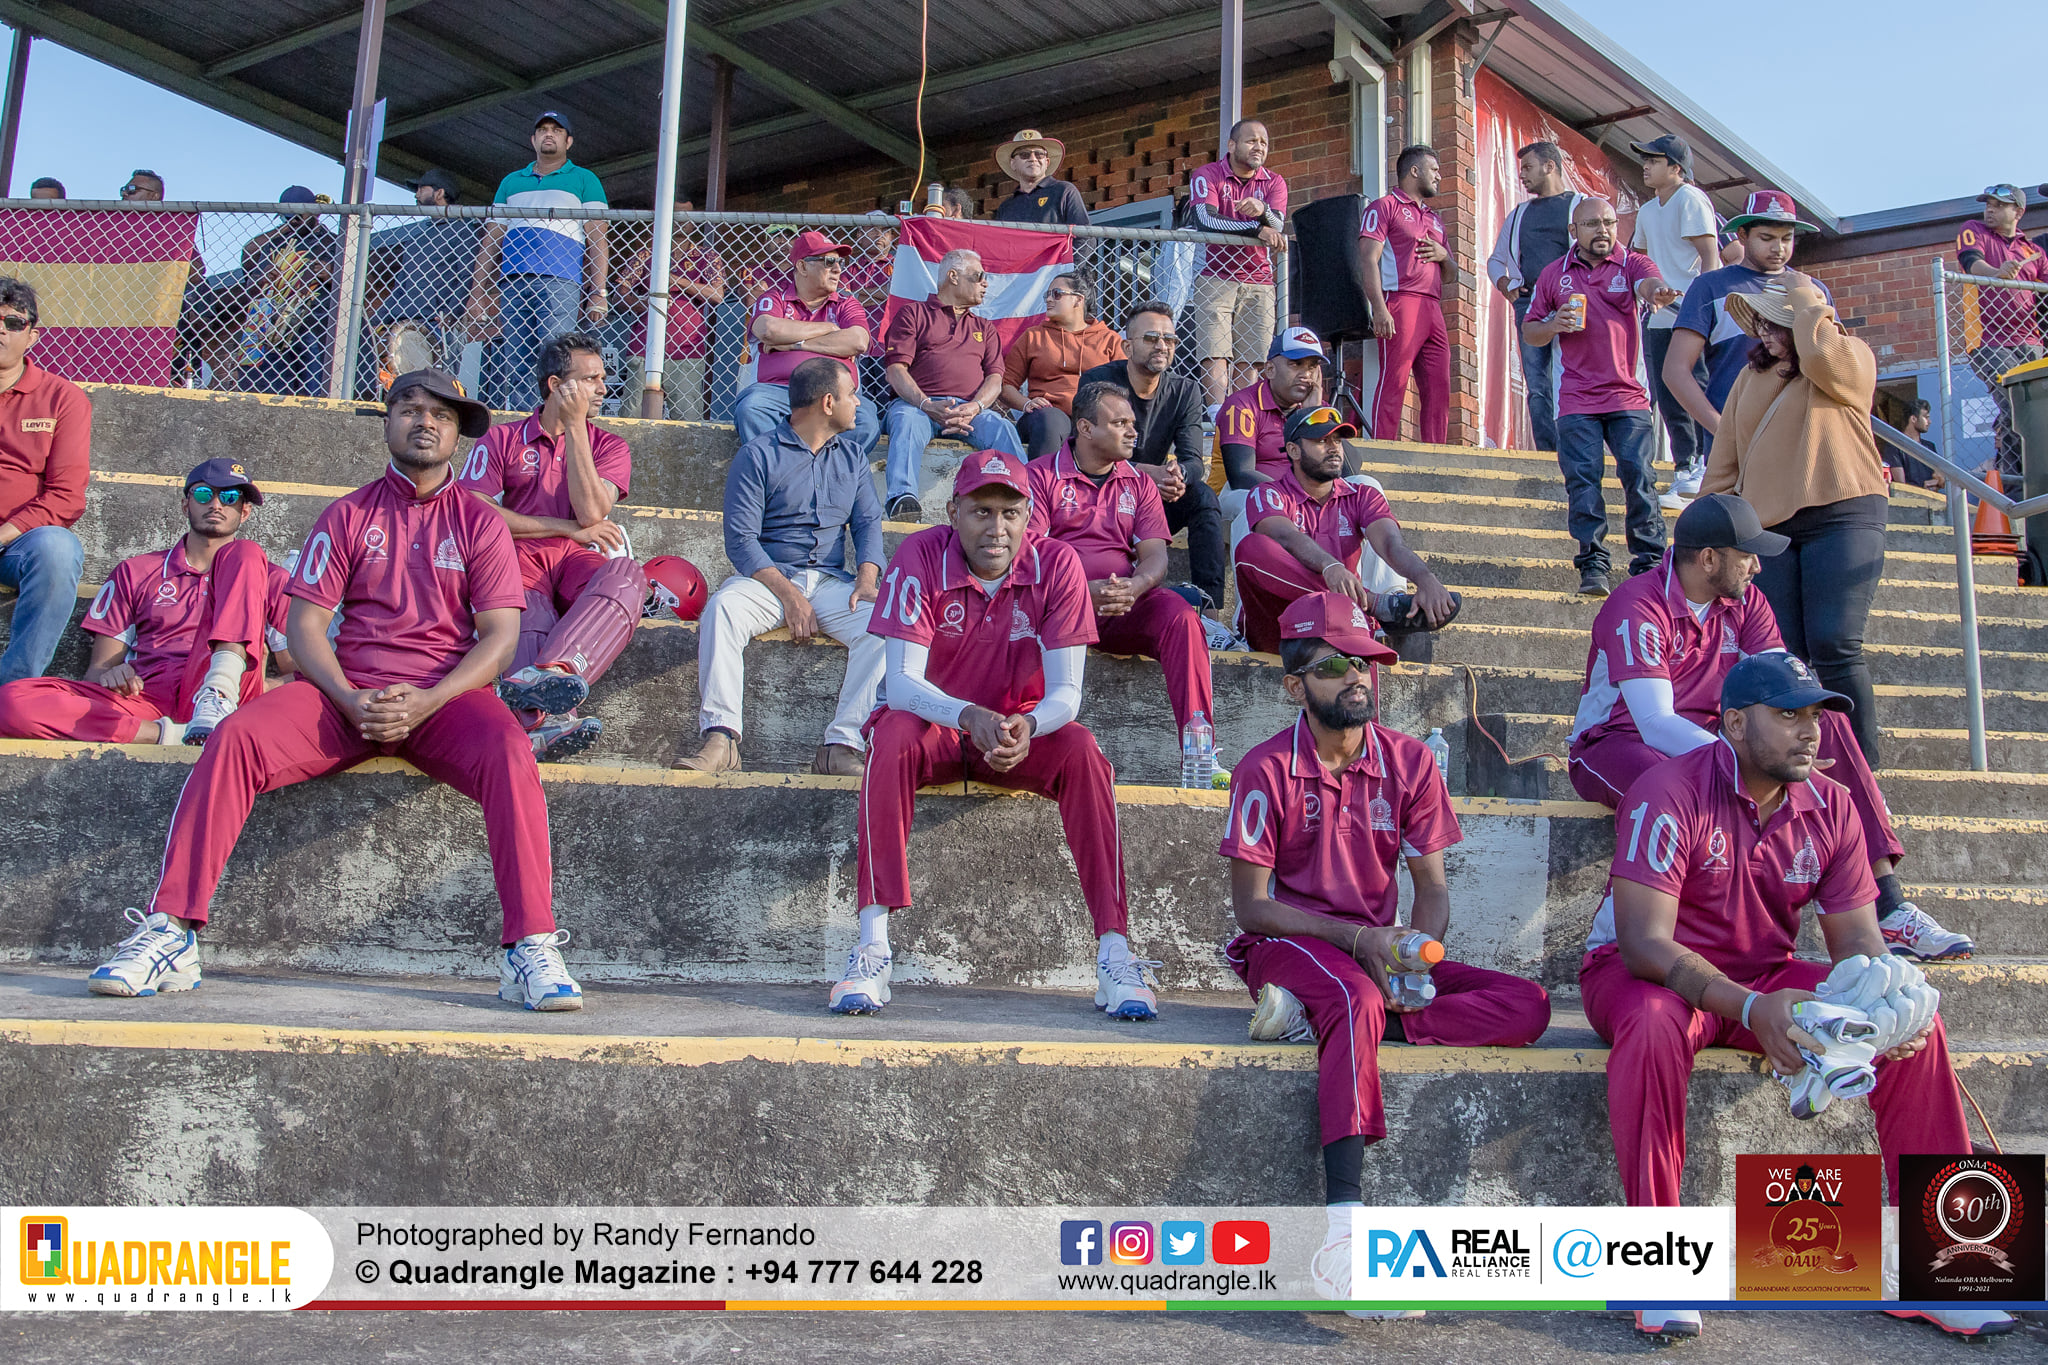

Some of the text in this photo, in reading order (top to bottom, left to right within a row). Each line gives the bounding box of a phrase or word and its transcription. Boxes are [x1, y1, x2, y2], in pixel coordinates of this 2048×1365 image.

[1190, 176, 1208, 201] 10
[1361, 209, 1378, 232] 10
[1957, 229, 1976, 250] 10
[1226, 405, 1256, 438] 10
[459, 444, 489, 480] 10
[1250, 487, 1284, 513] 10
[881, 566, 922, 626] 10
[1615, 619, 1661, 667] 10
[1224, 782, 1268, 847] 10
[1626, 801, 1679, 873] 10
